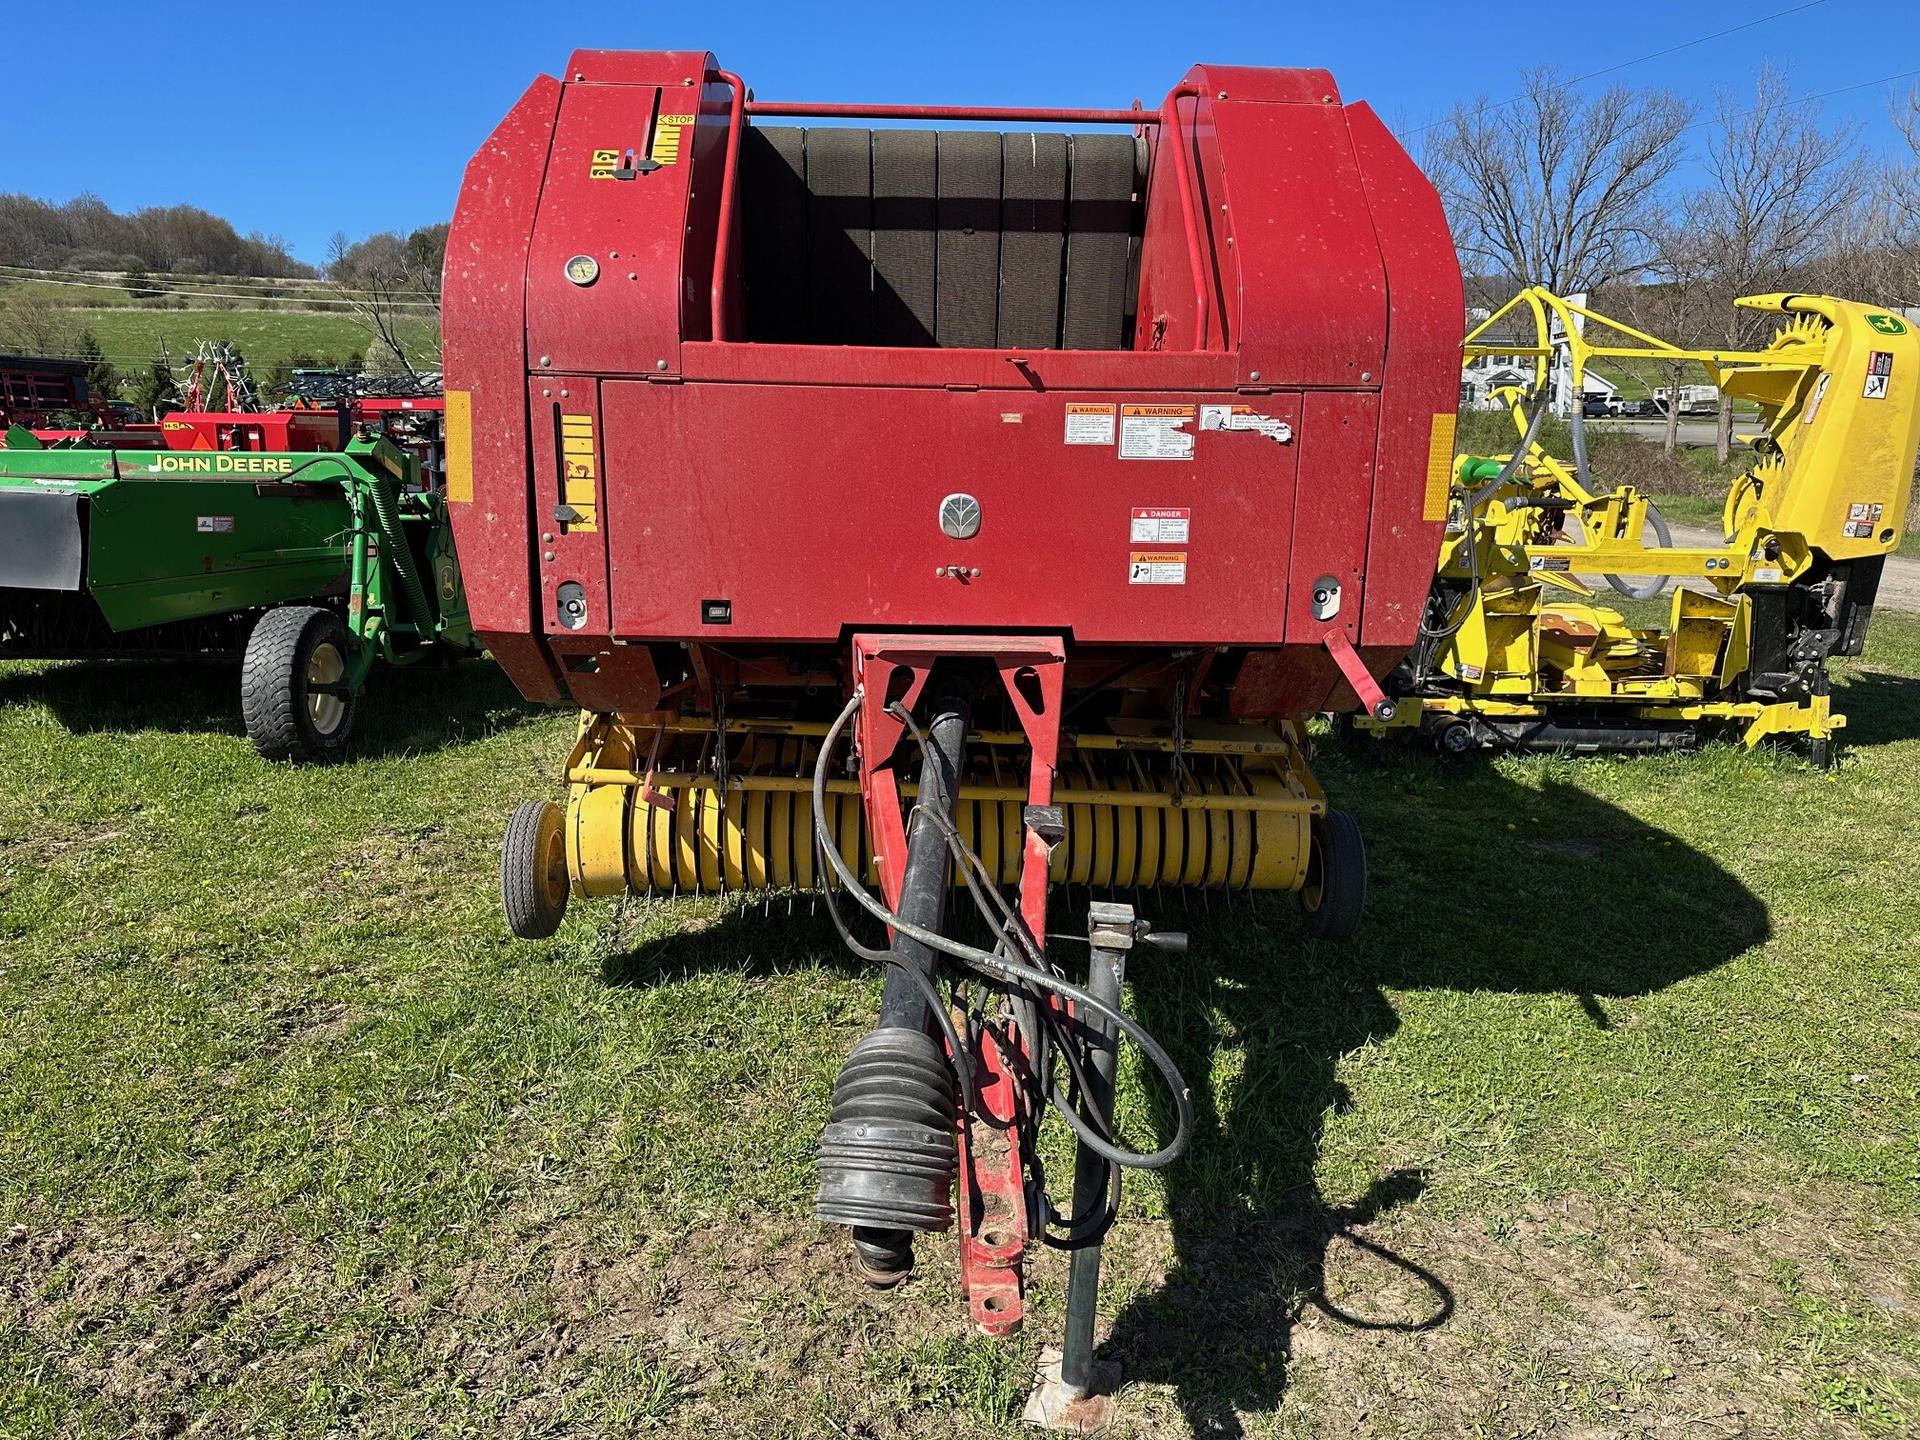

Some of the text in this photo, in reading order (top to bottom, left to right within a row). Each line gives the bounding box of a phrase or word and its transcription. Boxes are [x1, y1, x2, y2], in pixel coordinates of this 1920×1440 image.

[1144, 407, 1183, 415] WARNING
[148, 453, 293, 473] JOHN DEERE
[1150, 510, 1182, 518] DANGER
